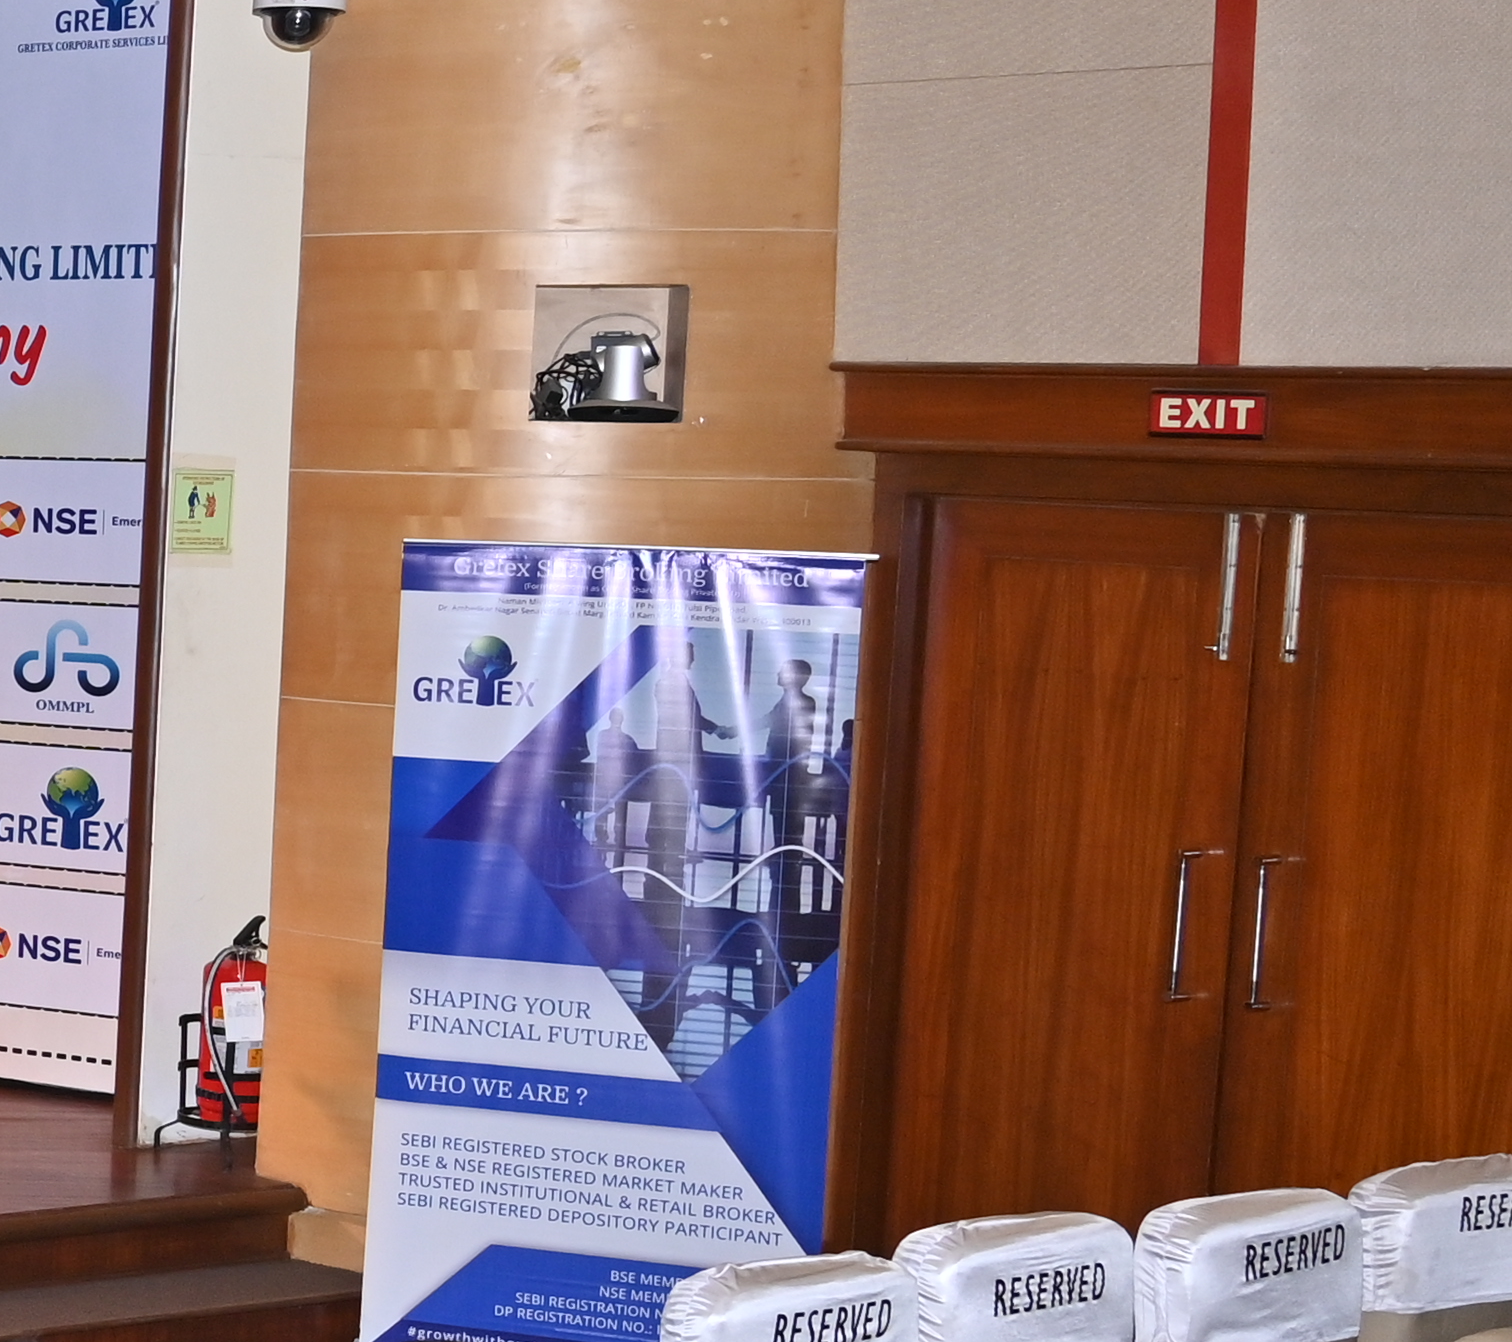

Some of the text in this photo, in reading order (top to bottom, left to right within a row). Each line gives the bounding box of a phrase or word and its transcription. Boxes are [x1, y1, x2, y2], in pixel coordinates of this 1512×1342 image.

[18, 42, 54, 53] GRETEX
[56, 39, 110, 51] CORPORATE
[112, 36, 155, 48] SERVICES
[49, 243, 157, 281] LIMIT
[1159, 397, 1256, 430] EXIT
[31, 507, 97, 535] NSE
[35, 699, 95, 714] OMMPL
[18, 933, 82, 965] NSE
[409, 988, 591, 1019] SHAPING YOUR
[408, 1014, 648, 1051] FINANCIAL FUTURE
[405, 1071, 588, 1106] WHO WE ARE ?
[401, 1133, 685, 1174] SEBI REGISTERED STOCK BROKER
[400, 1153, 743, 1200] BSE & NSE REGISTERED MARKET MAKER
[398, 1172, 775, 1225] TRUSTED INSTITUTIONAL & RETAIL BROKER
[397, 1192, 782, 1246] SEBI REGISTERED DEPOSITORY PARTICIPANT
[1243, 1224, 1347, 1283] RESERVED
[599, 1286, 626, 1300] NSE
[610, 1270, 636, 1283] BSE
[992, 1261, 1107, 1317] RESERVED
[494, 1305, 513, 1317] DP
[517, 1307, 617, 1330] REGISTRATION
[515, 1292, 545, 1306] SEBI
[549, 1296, 650, 1318] REGISTRATION
